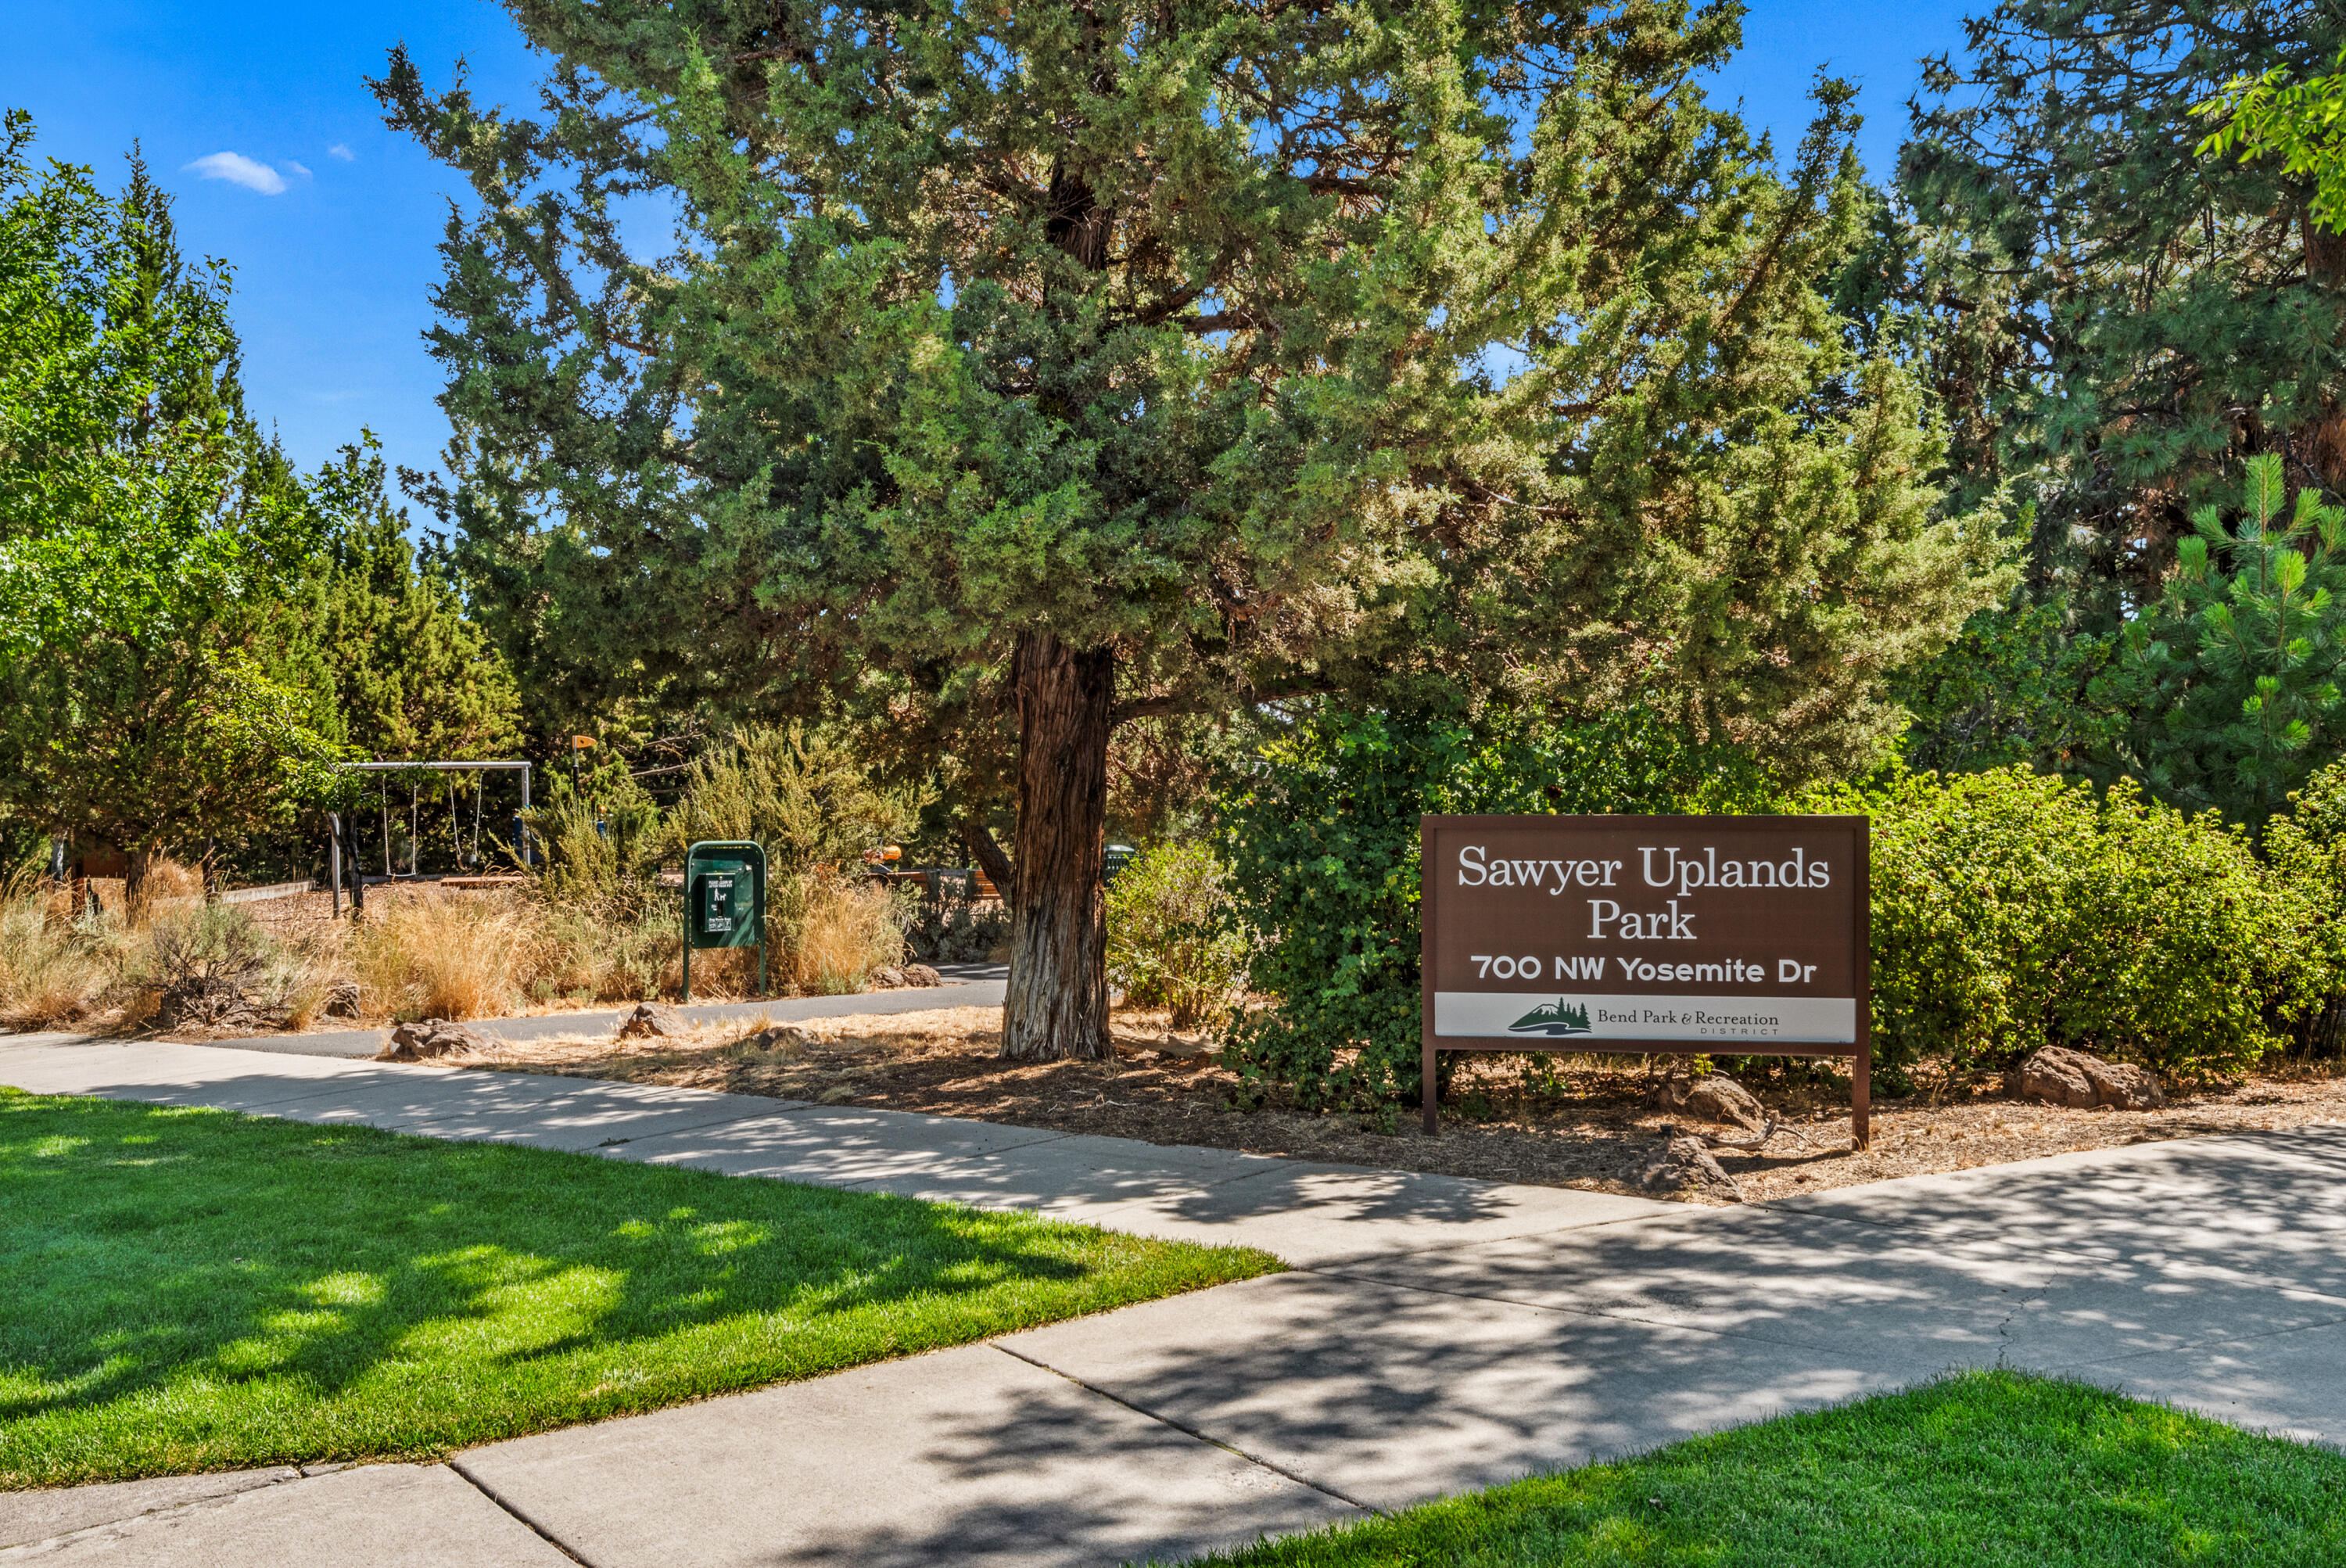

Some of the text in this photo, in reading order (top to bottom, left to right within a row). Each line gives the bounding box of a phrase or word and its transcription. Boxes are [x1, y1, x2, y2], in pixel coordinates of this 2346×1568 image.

[1458, 845, 1831, 896] Sawyer Uplands
[1587, 899, 1698, 940] Park
[1470, 955, 1817, 983] 700 NW Yosemite Dr
[1598, 1009, 1780, 1025] Bend Park & Recreation
[1700, 1027, 1779, 1035] DISTRICT
